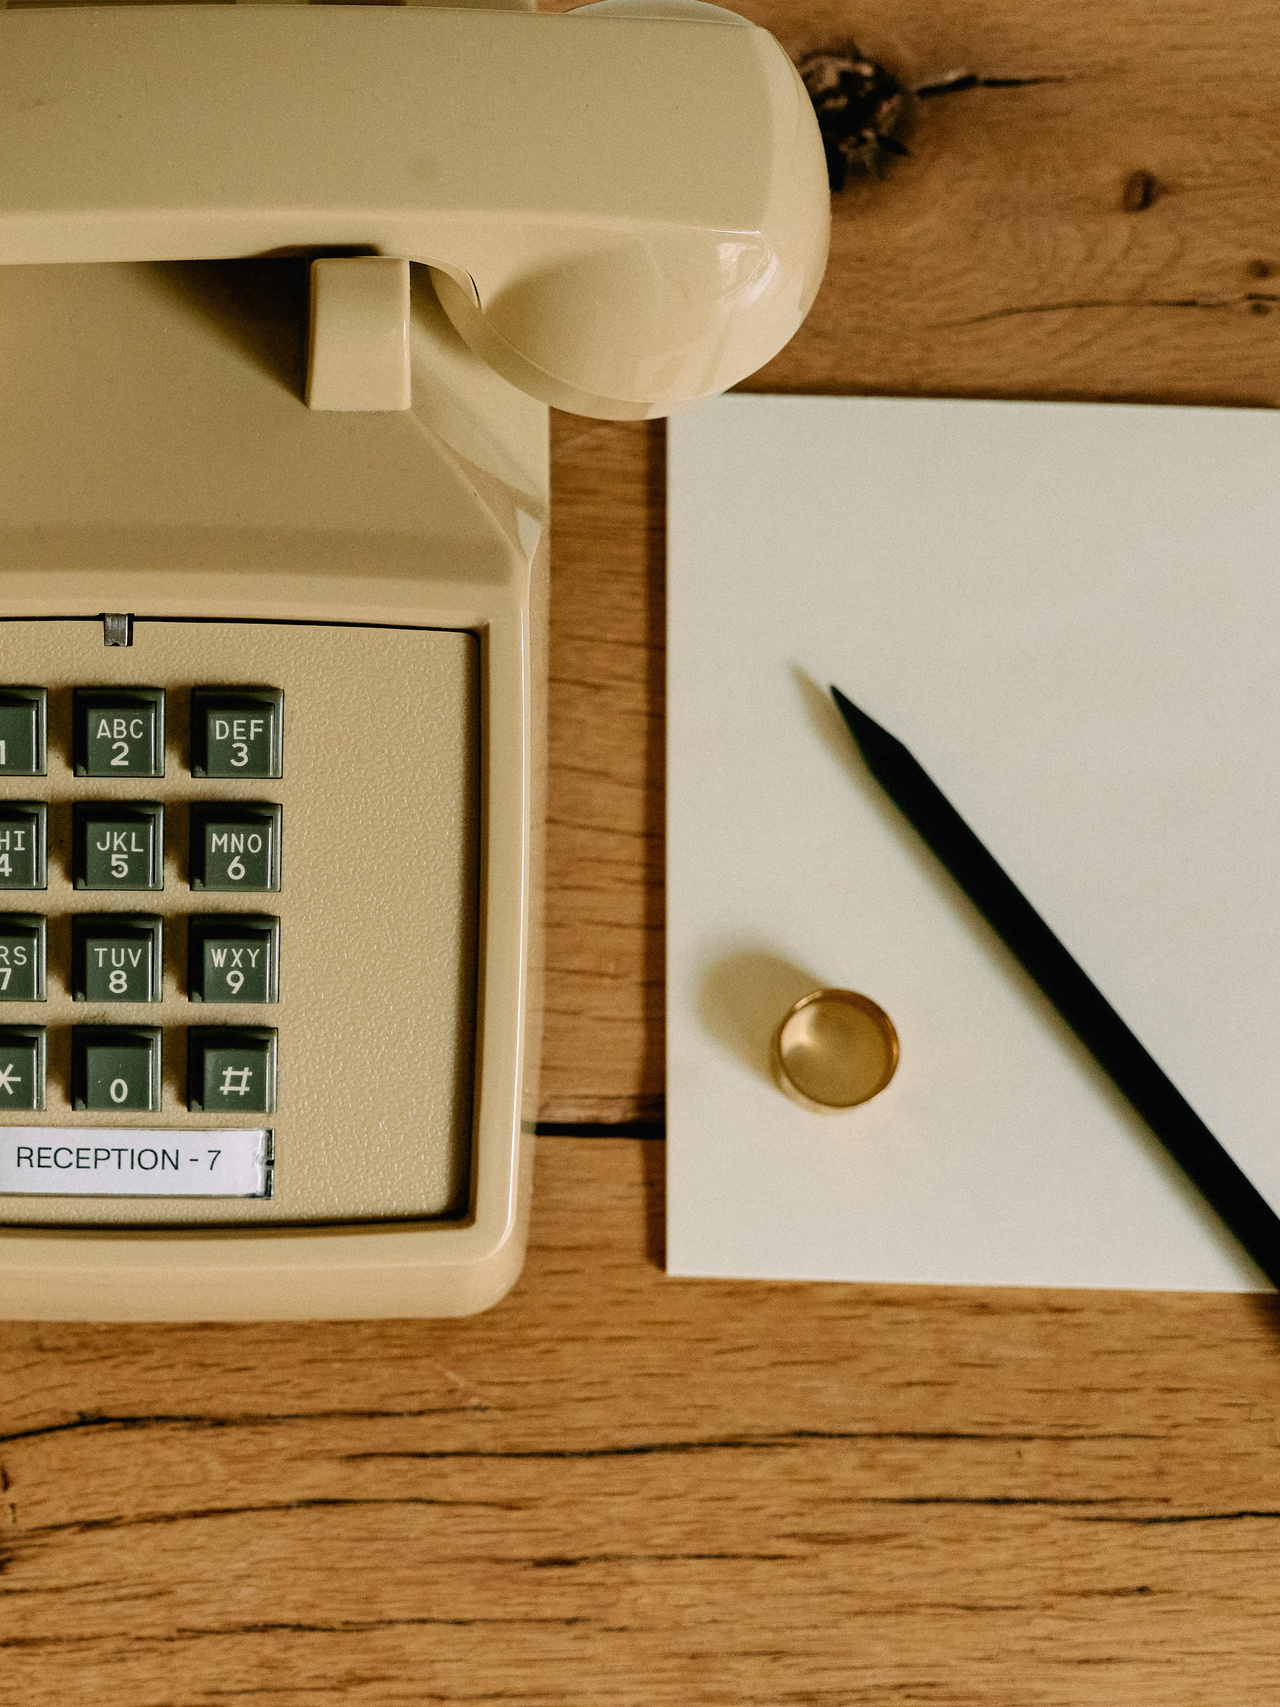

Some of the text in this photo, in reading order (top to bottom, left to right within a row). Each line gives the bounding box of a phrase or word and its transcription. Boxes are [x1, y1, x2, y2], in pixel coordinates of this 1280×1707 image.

[96, 718, 144, 739] ABC
[215, 719, 264, 741] DEF
[110, 741, 129, 766] 2
[229, 742, 249, 767] 3
[96, 831, 144, 853] JKL
[211, 832, 263, 854] MNO
[110, 853, 129, 879] 5
[227, 855, 246, 881] 6
[93, 947, 142, 968] TUV
[210, 948, 260, 968] WXY
[108, 969, 128, 994] 8
[225, 969, 245, 995] 9
[109, 1078, 129, 1104] 0
[219, 1066, 253, 1096] #
[16, 1146, 179, 1171] RECEPTION
